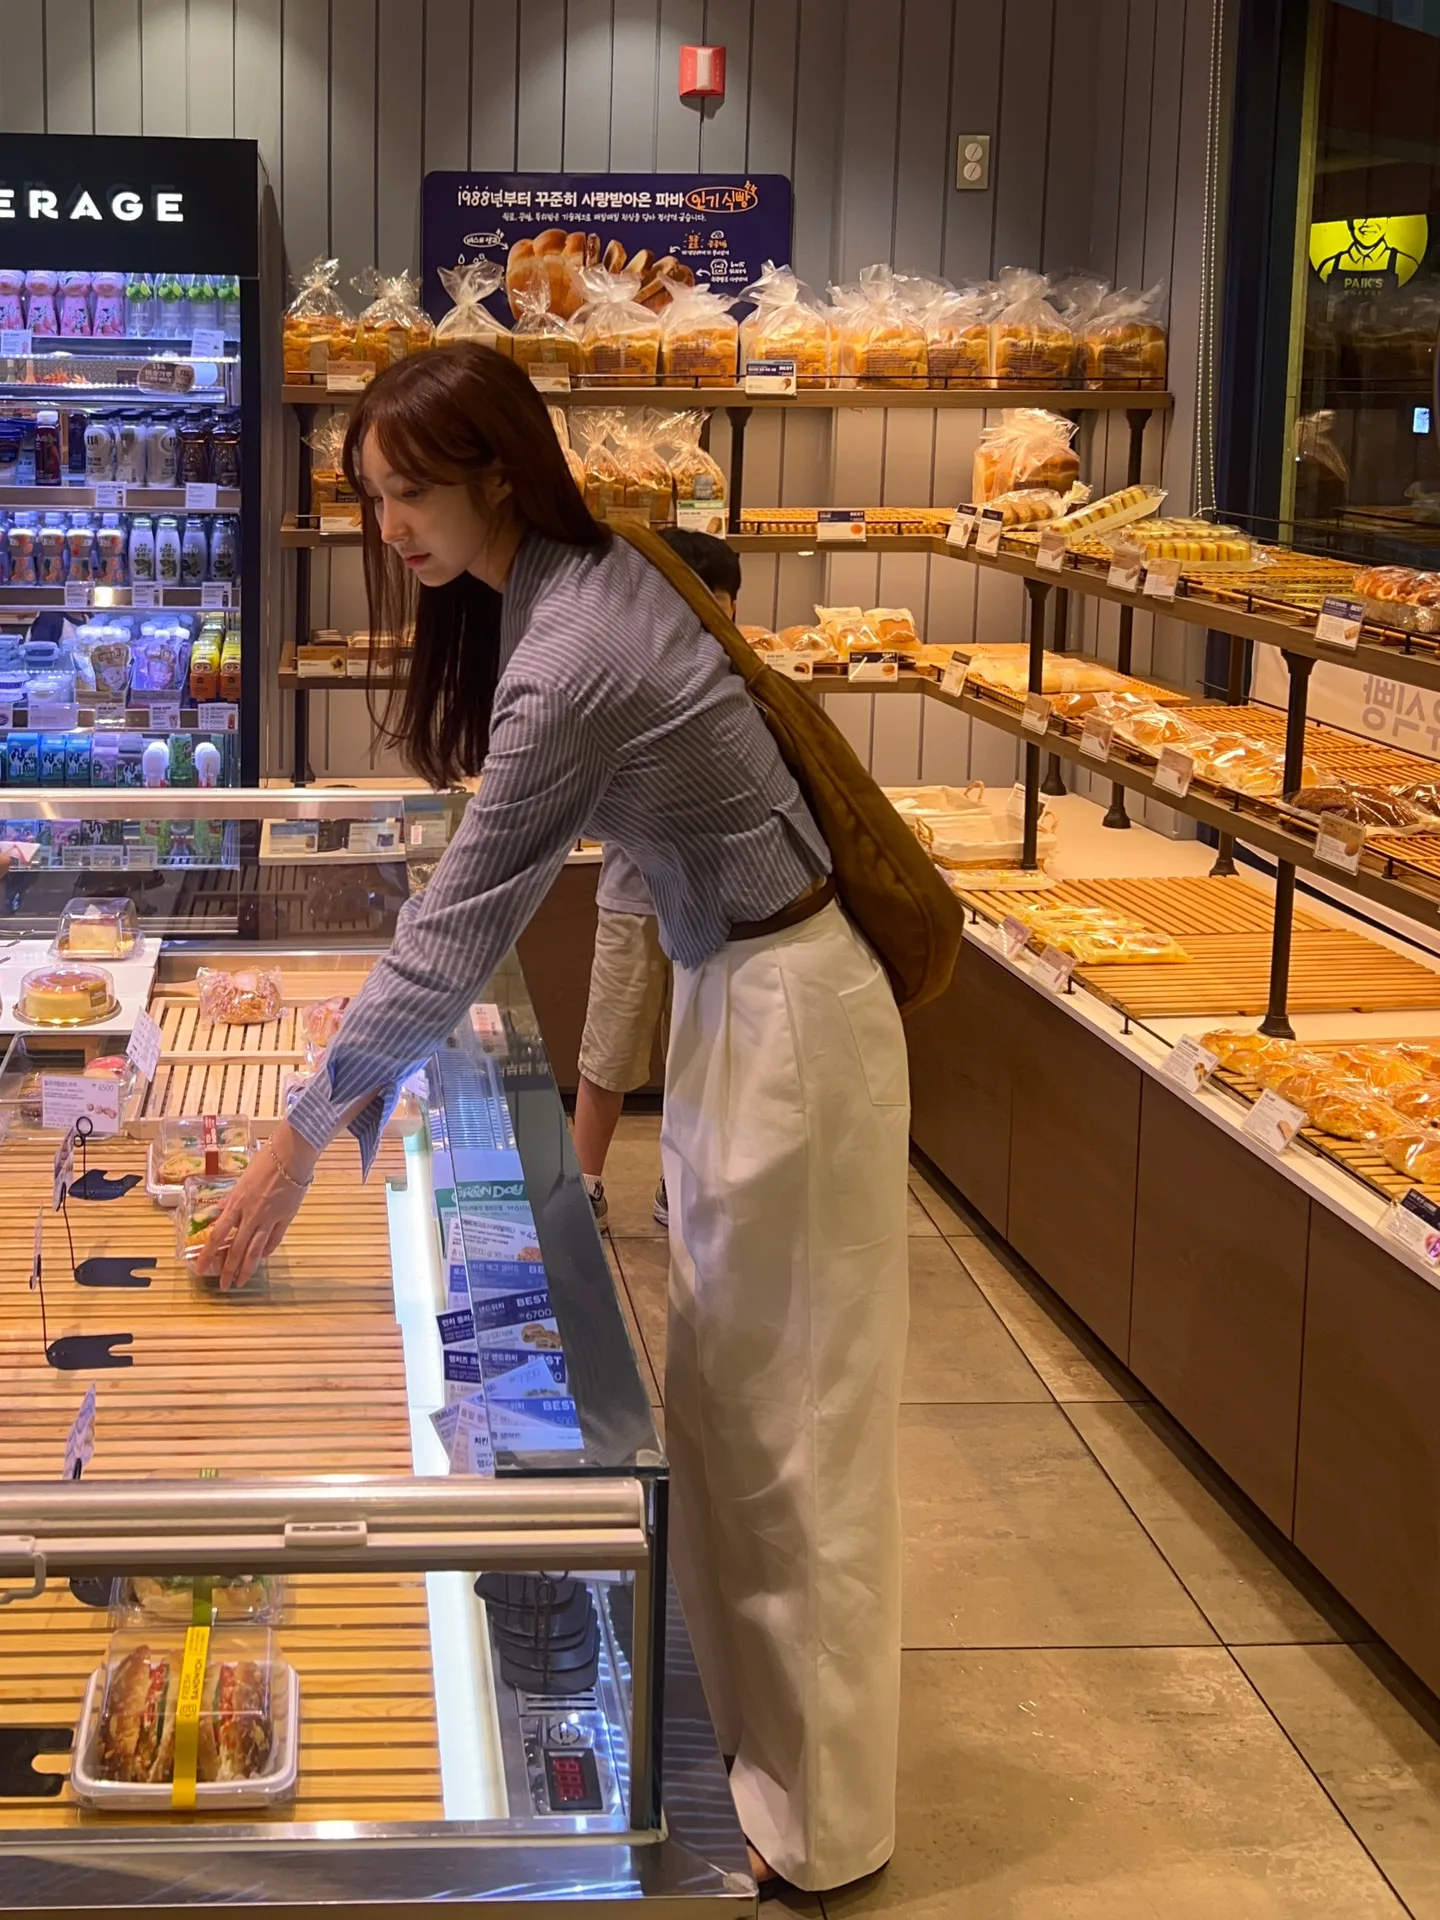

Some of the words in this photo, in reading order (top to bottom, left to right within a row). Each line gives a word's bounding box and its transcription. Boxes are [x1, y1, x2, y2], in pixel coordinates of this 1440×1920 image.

[457, 189, 531, 208] 1988년부터
[535, 191, 577, 207] 꾸준히
[581, 191, 652, 208] 사랑받아온
[655, 192, 684, 208] 파바
[691, 191, 720, 209] 인기
[721, 190, 751, 211] 식빵
[561, 212, 592, 222] 기술력으로
[594, 212, 620, 222] 매일매일
[641, 213, 656, 222] 담아
[1343, 277, 1384, 289] PAIK'S
[516, 1293, 548, 1308] BEST
[191, 1659, 202, 1700] SANDWICH
